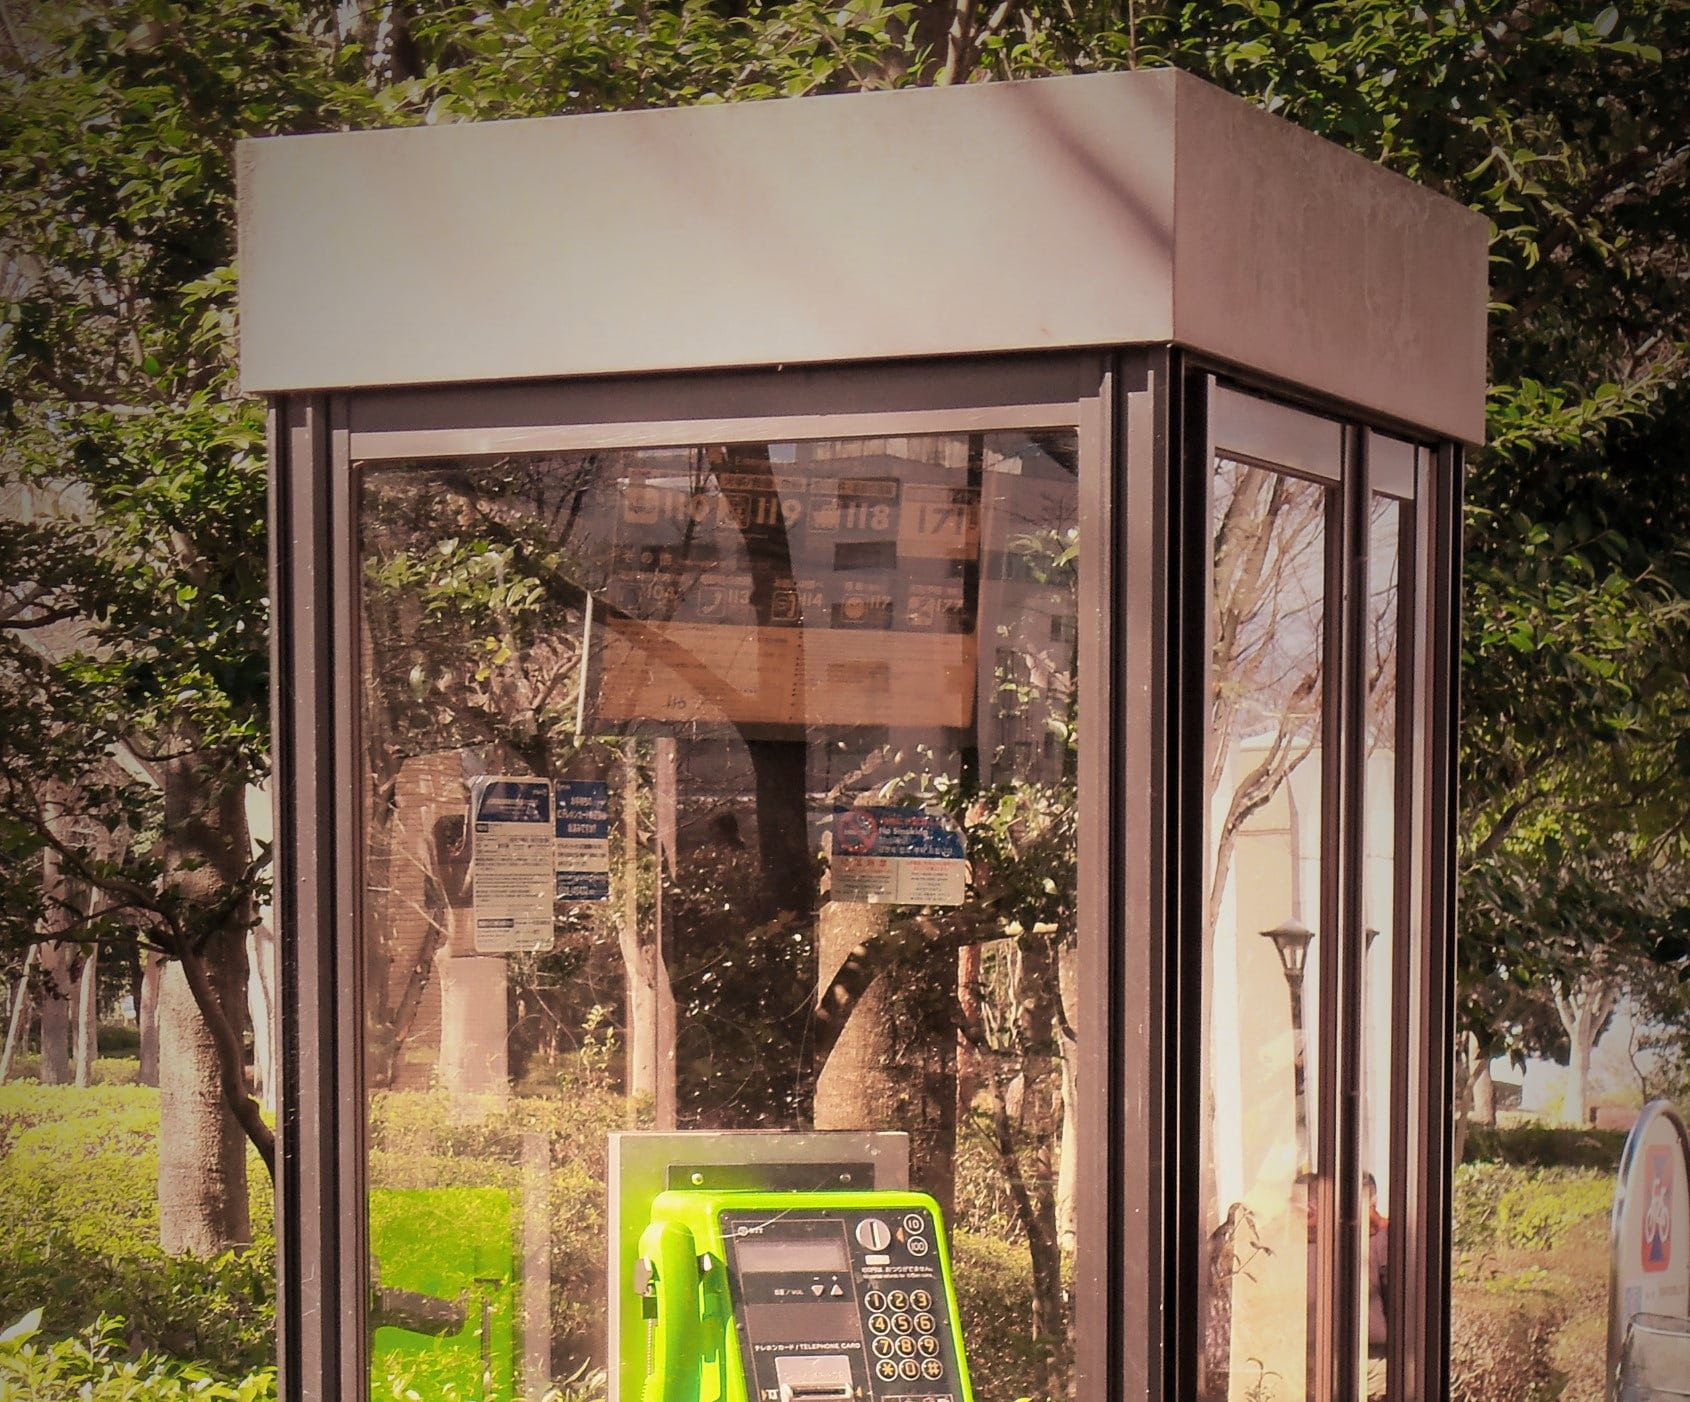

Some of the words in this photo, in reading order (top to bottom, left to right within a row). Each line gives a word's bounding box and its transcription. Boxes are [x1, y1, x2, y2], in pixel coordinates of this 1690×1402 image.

[757, 497, 802, 527] 119
[846, 498, 890, 530] 118
[918, 504, 968, 535] 171
[908, 1219, 920, 1229] 10
[910, 1241, 925, 1251] 100
[894, 1293, 905, 1307] 2
[917, 1293, 928, 1306] 3
[875, 1316, 885, 1330] 4
[897, 1316, 908, 1330] 5
[920, 1316, 931, 1329] 6
[800, 1342, 840, 1350] TELEPHONE
[879, 1340, 889, 1353] 7
[901, 1339, 912, 1353] 8
[923, 1339, 934, 1352] 9
[905, 1362, 916, 1375] 0
